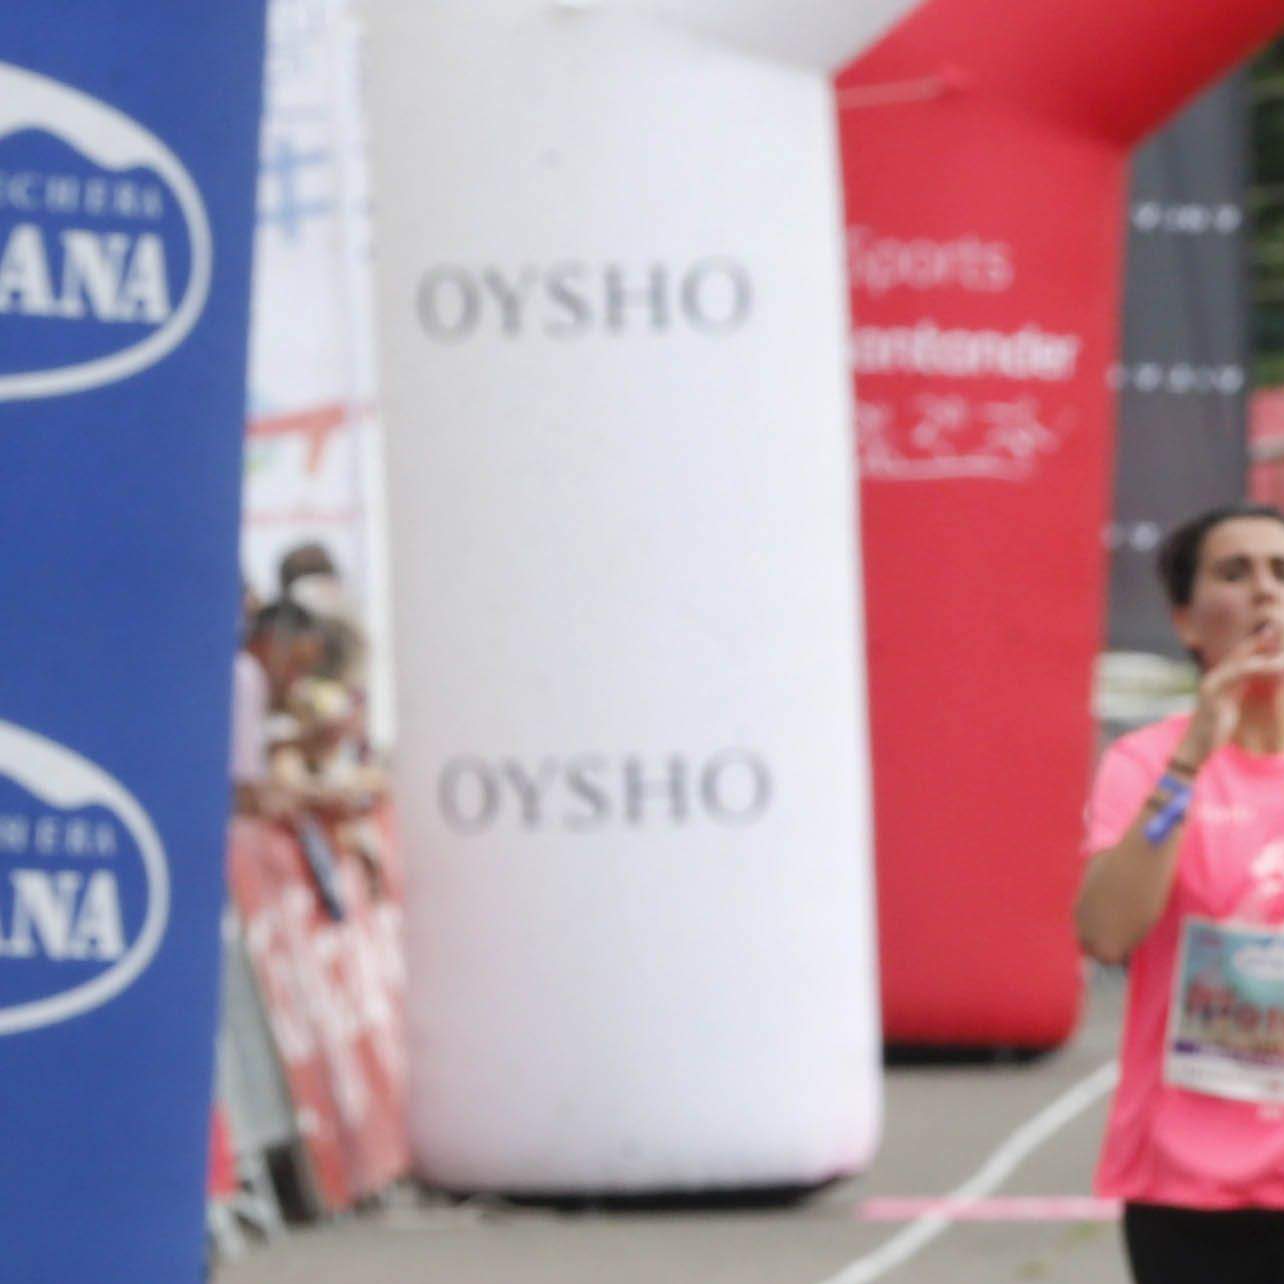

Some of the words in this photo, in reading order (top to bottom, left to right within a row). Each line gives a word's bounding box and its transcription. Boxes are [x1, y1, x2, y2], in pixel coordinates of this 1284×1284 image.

[416, 254, 755, 348] OYSHO
[852, 316, 1082, 382] antander
[437, 744, 776, 838] OYSHO
[0, 867, 127, 962] NA
